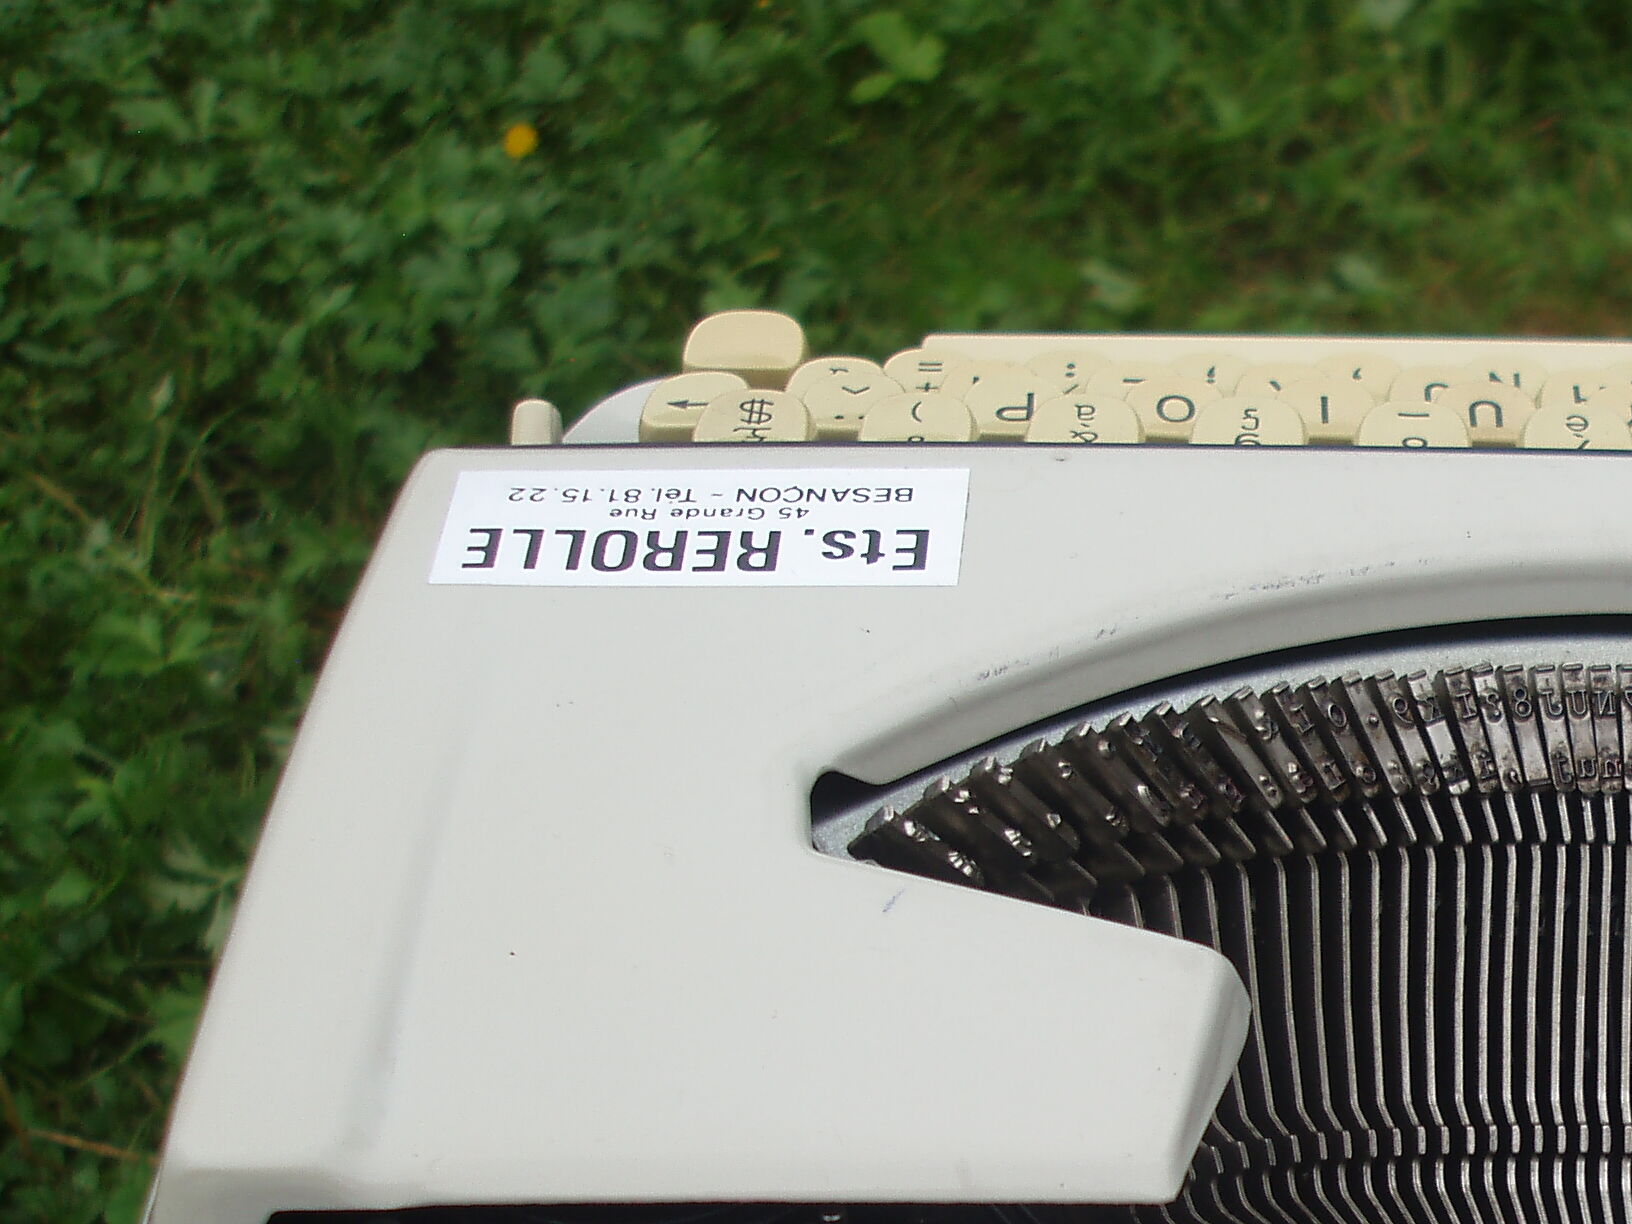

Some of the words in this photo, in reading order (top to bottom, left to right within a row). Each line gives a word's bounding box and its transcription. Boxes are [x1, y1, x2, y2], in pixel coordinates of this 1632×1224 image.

[995, 392, 1035, 422] P
[1156, 395, 1195, 422] O
[1468, 401, 1503, 428] U
[507, 487, 641, 504] 81.15.22
[737, 485, 914, 503] BESANÇON
[608, 507, 658, 520] Rue
[669, 507, 766, 521] Grande
[777, 507, 810, 520] 45
[460, 527, 782, 573] REROLLE
[803, 527, 931, 573] Ets.
